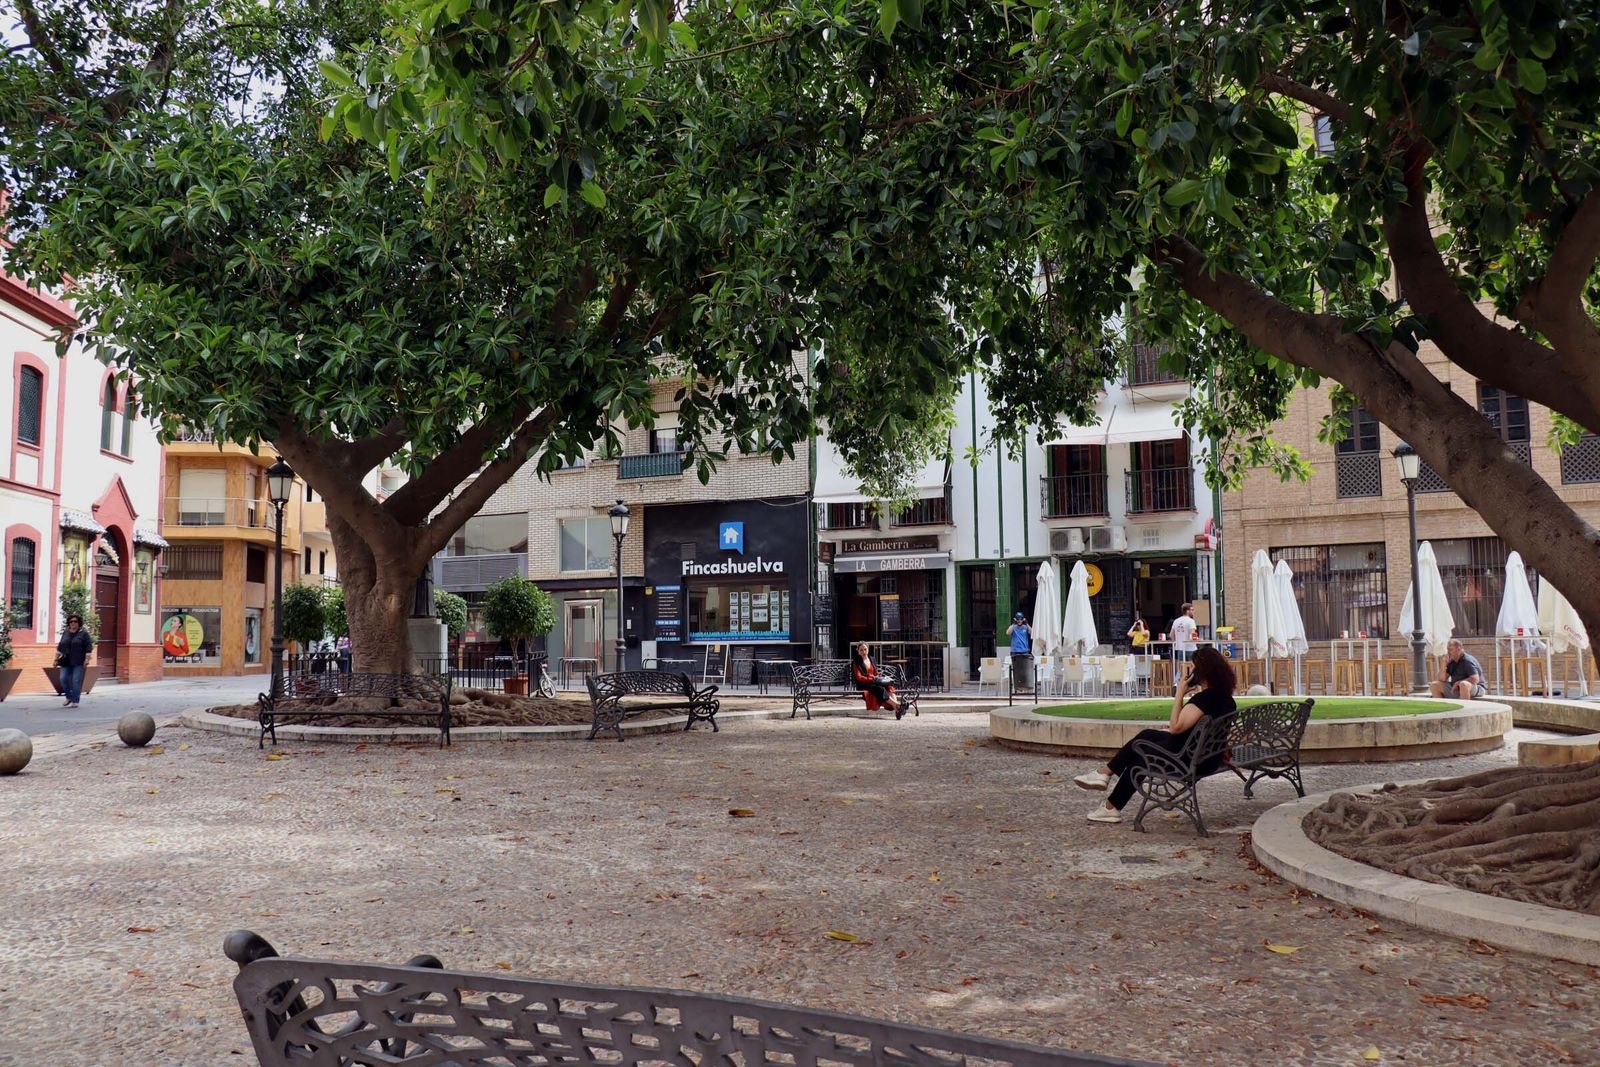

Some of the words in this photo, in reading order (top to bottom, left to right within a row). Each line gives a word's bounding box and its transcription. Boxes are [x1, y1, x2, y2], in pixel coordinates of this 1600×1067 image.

[844, 541, 856, 552] La
[859, 540, 909, 552] Gamberra
[681, 556, 784, 576] Fincashuelva
[856, 561, 867, 572] LA
[880, 558, 926, 571] GAMBERRA
